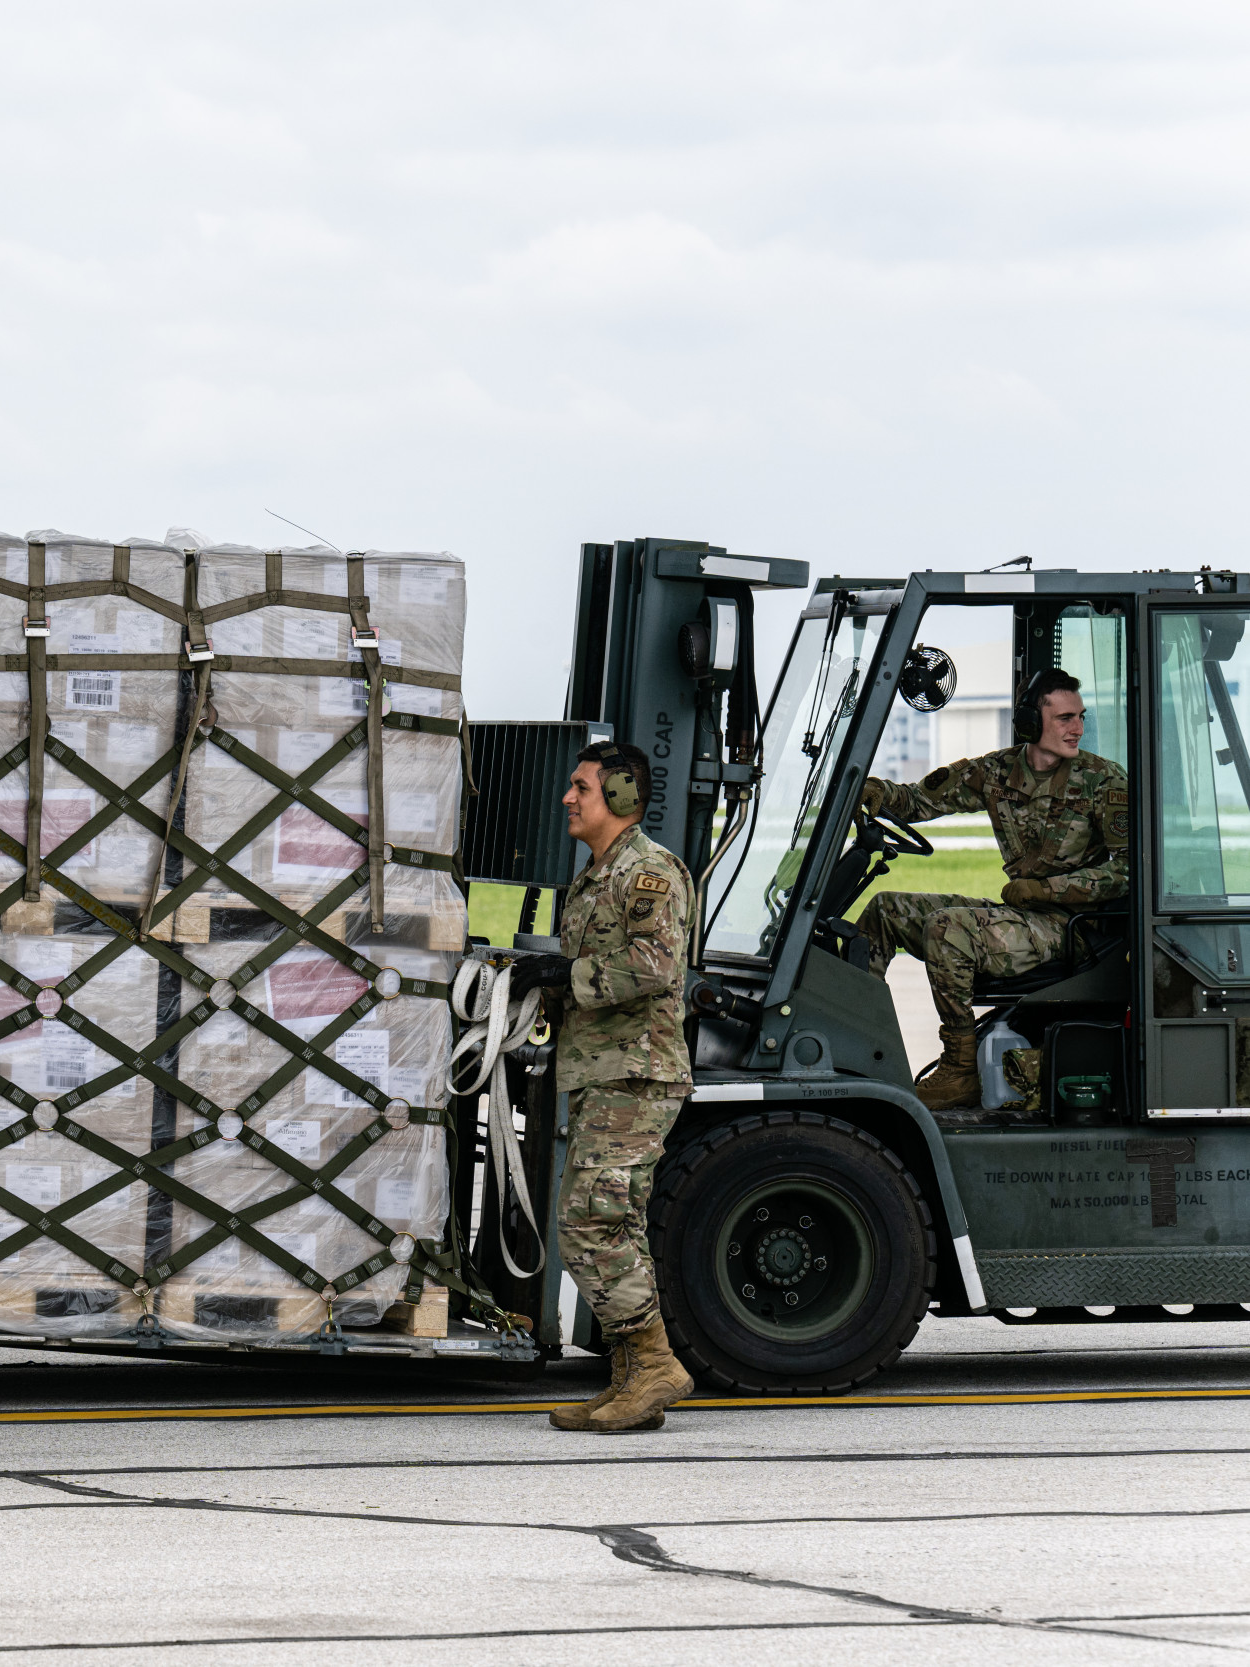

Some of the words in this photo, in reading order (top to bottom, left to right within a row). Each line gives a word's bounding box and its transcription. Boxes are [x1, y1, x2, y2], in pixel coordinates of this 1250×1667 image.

[653, 711, 674, 760] CAP
[646, 766, 669, 835] 10,000
[641, 876, 665, 890] GT
[818, 1088, 833, 1097] 100
[834, 1087, 849, 1097] PSI
[1051, 1141, 1091, 1153] DIESEL
[1096, 1139, 1126, 1152] FUEL
[984, 1172, 1006, 1184] TIE
[1010, 1171, 1054, 1184] DOWN
[1058, 1172, 1100, 1183] PLATE
[1107, 1171, 1135, 1183] CAP
[1185, 1170, 1212, 1182] LBS
[1050, 1197, 1081, 1209] MAX
[1133, 1195, 1152, 1207] LB
[1177, 1194, 1208, 1206] OTAL
